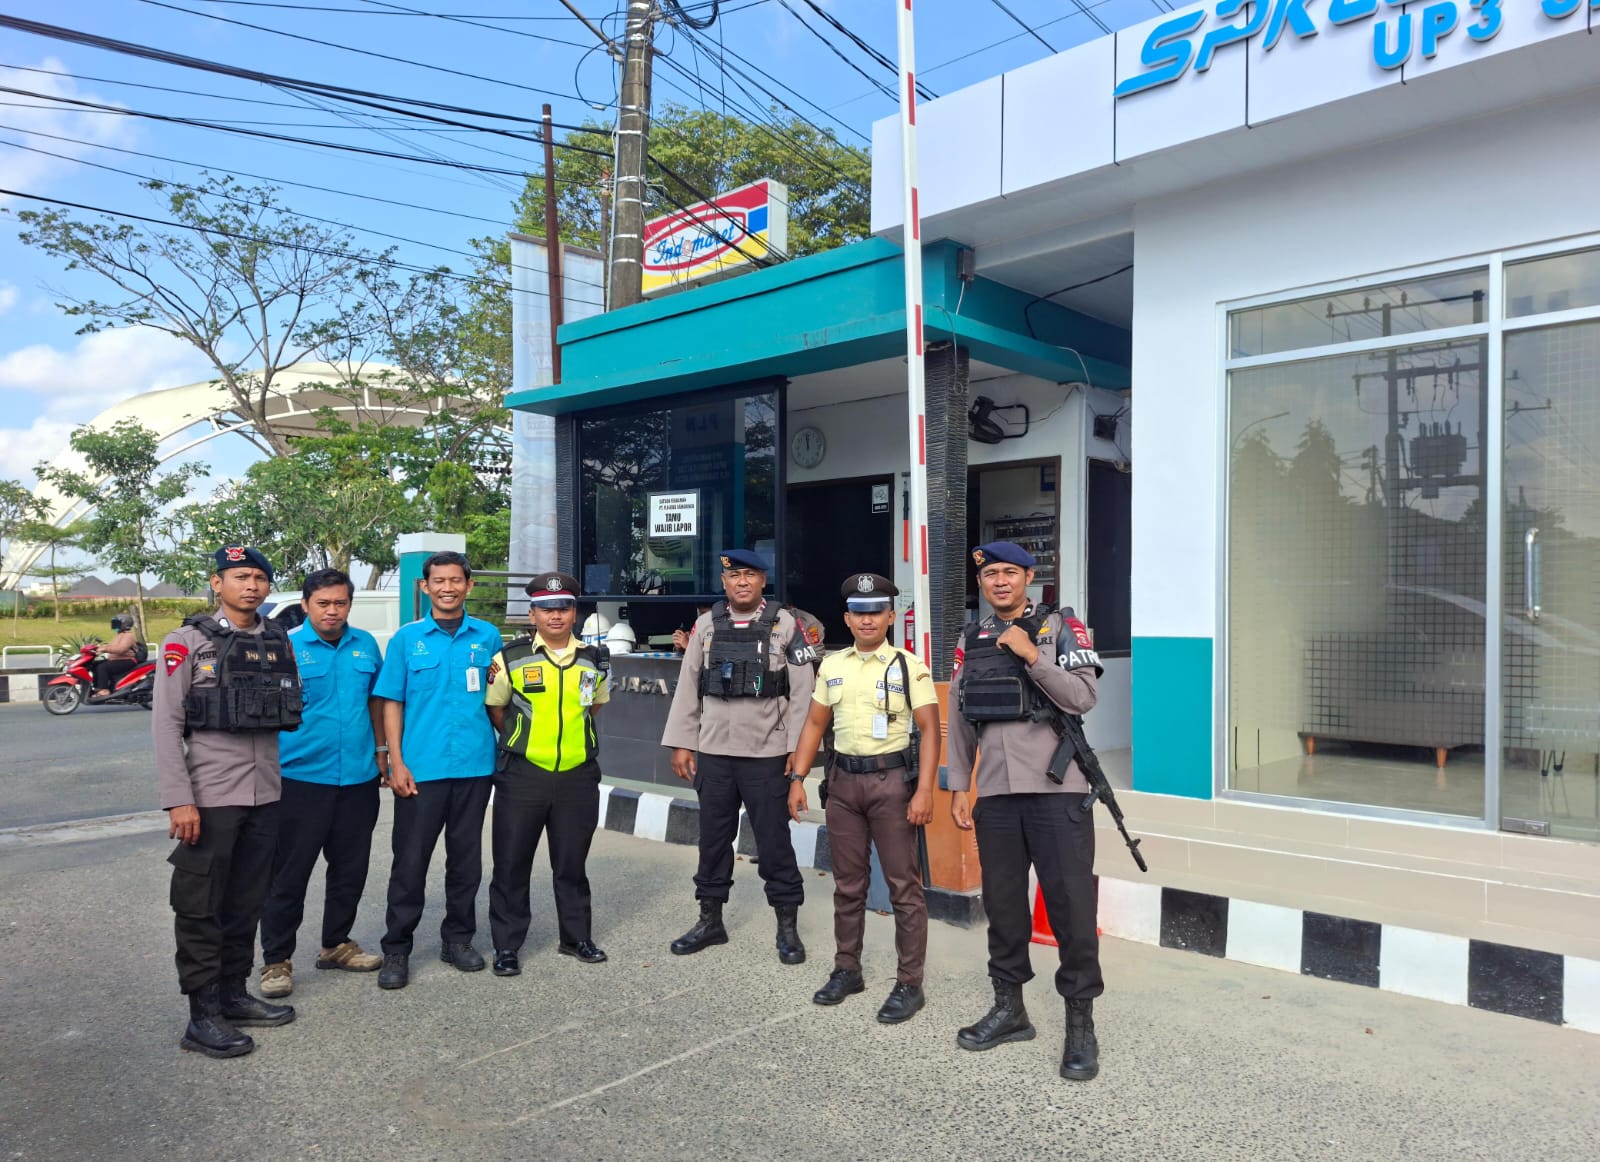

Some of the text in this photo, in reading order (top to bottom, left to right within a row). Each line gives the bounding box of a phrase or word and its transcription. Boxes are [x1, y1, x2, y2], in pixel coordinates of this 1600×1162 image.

[1373, 0, 1504, 69] UP3
[665, 513, 681, 522] TAMU
[655, 523, 692, 533] WAJIB LAPOR
[245, 650, 277, 662] POSI
[879, 682, 904, 692] STPAM
